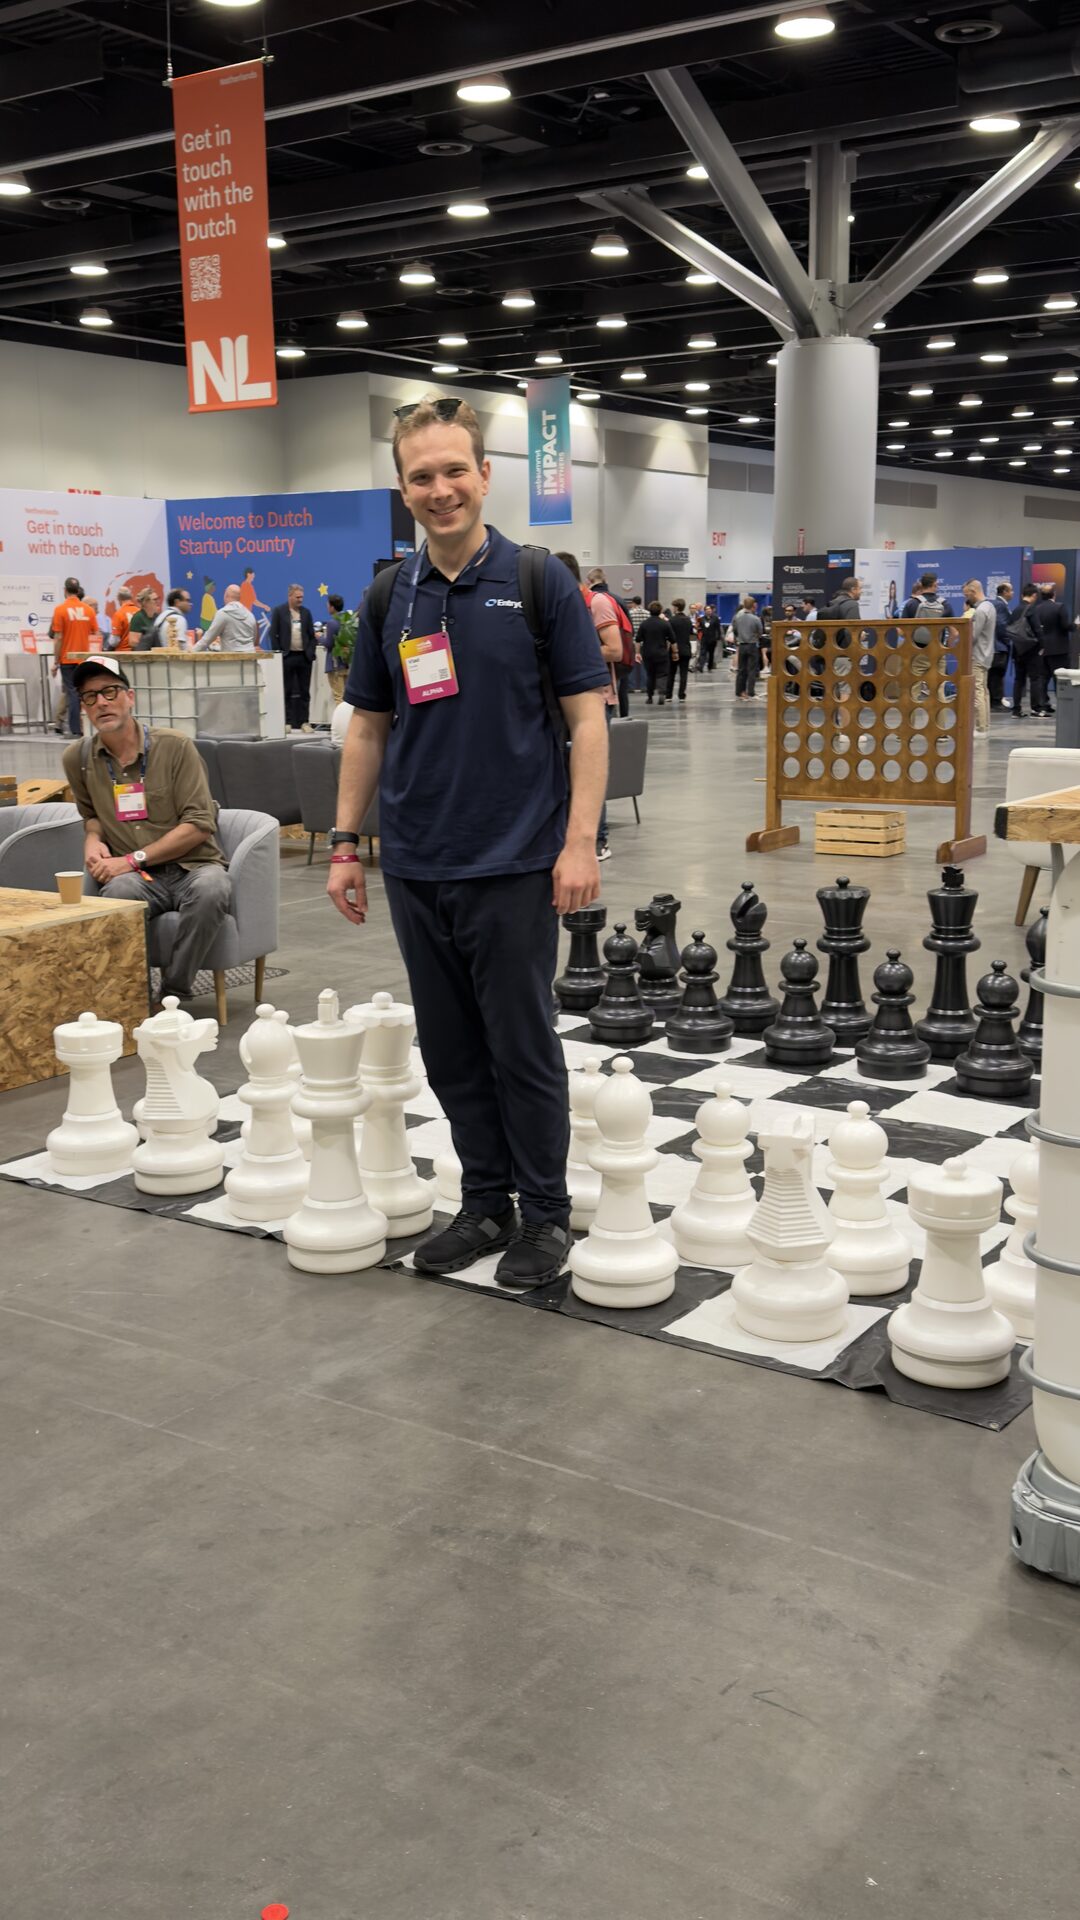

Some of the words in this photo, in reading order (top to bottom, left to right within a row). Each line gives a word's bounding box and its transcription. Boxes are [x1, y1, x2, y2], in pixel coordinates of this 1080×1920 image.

[182, 128, 213, 153] Get
[215, 123, 231, 147] in
[182, 152, 232, 183] touch
[184, 185, 221, 212] with
[224, 181, 254, 205] the
[186, 212, 236, 242] Dutch
[191, 334, 272, 405] NL
[542, 410, 557, 496] IMPACT
[26, 519, 50, 535] Get
[53, 519, 65, 535] in
[67, 522, 103, 537] touch
[177, 511, 246, 531] Welcome
[248, 512, 264, 529] to
[267, 507, 313, 528] Dutch
[27, 538, 56, 555] with
[59, 540, 80, 556] the
[82, 542, 119, 558] Dutch
[179, 538, 233, 559] Startup
[236, 536, 296, 557] Country
[713, 532, 727, 546] EXIT
[634, 550, 660, 560] EXHIBIT
[66, 606, 90, 621] NL
[422, 687, 444, 697] ALPHA
